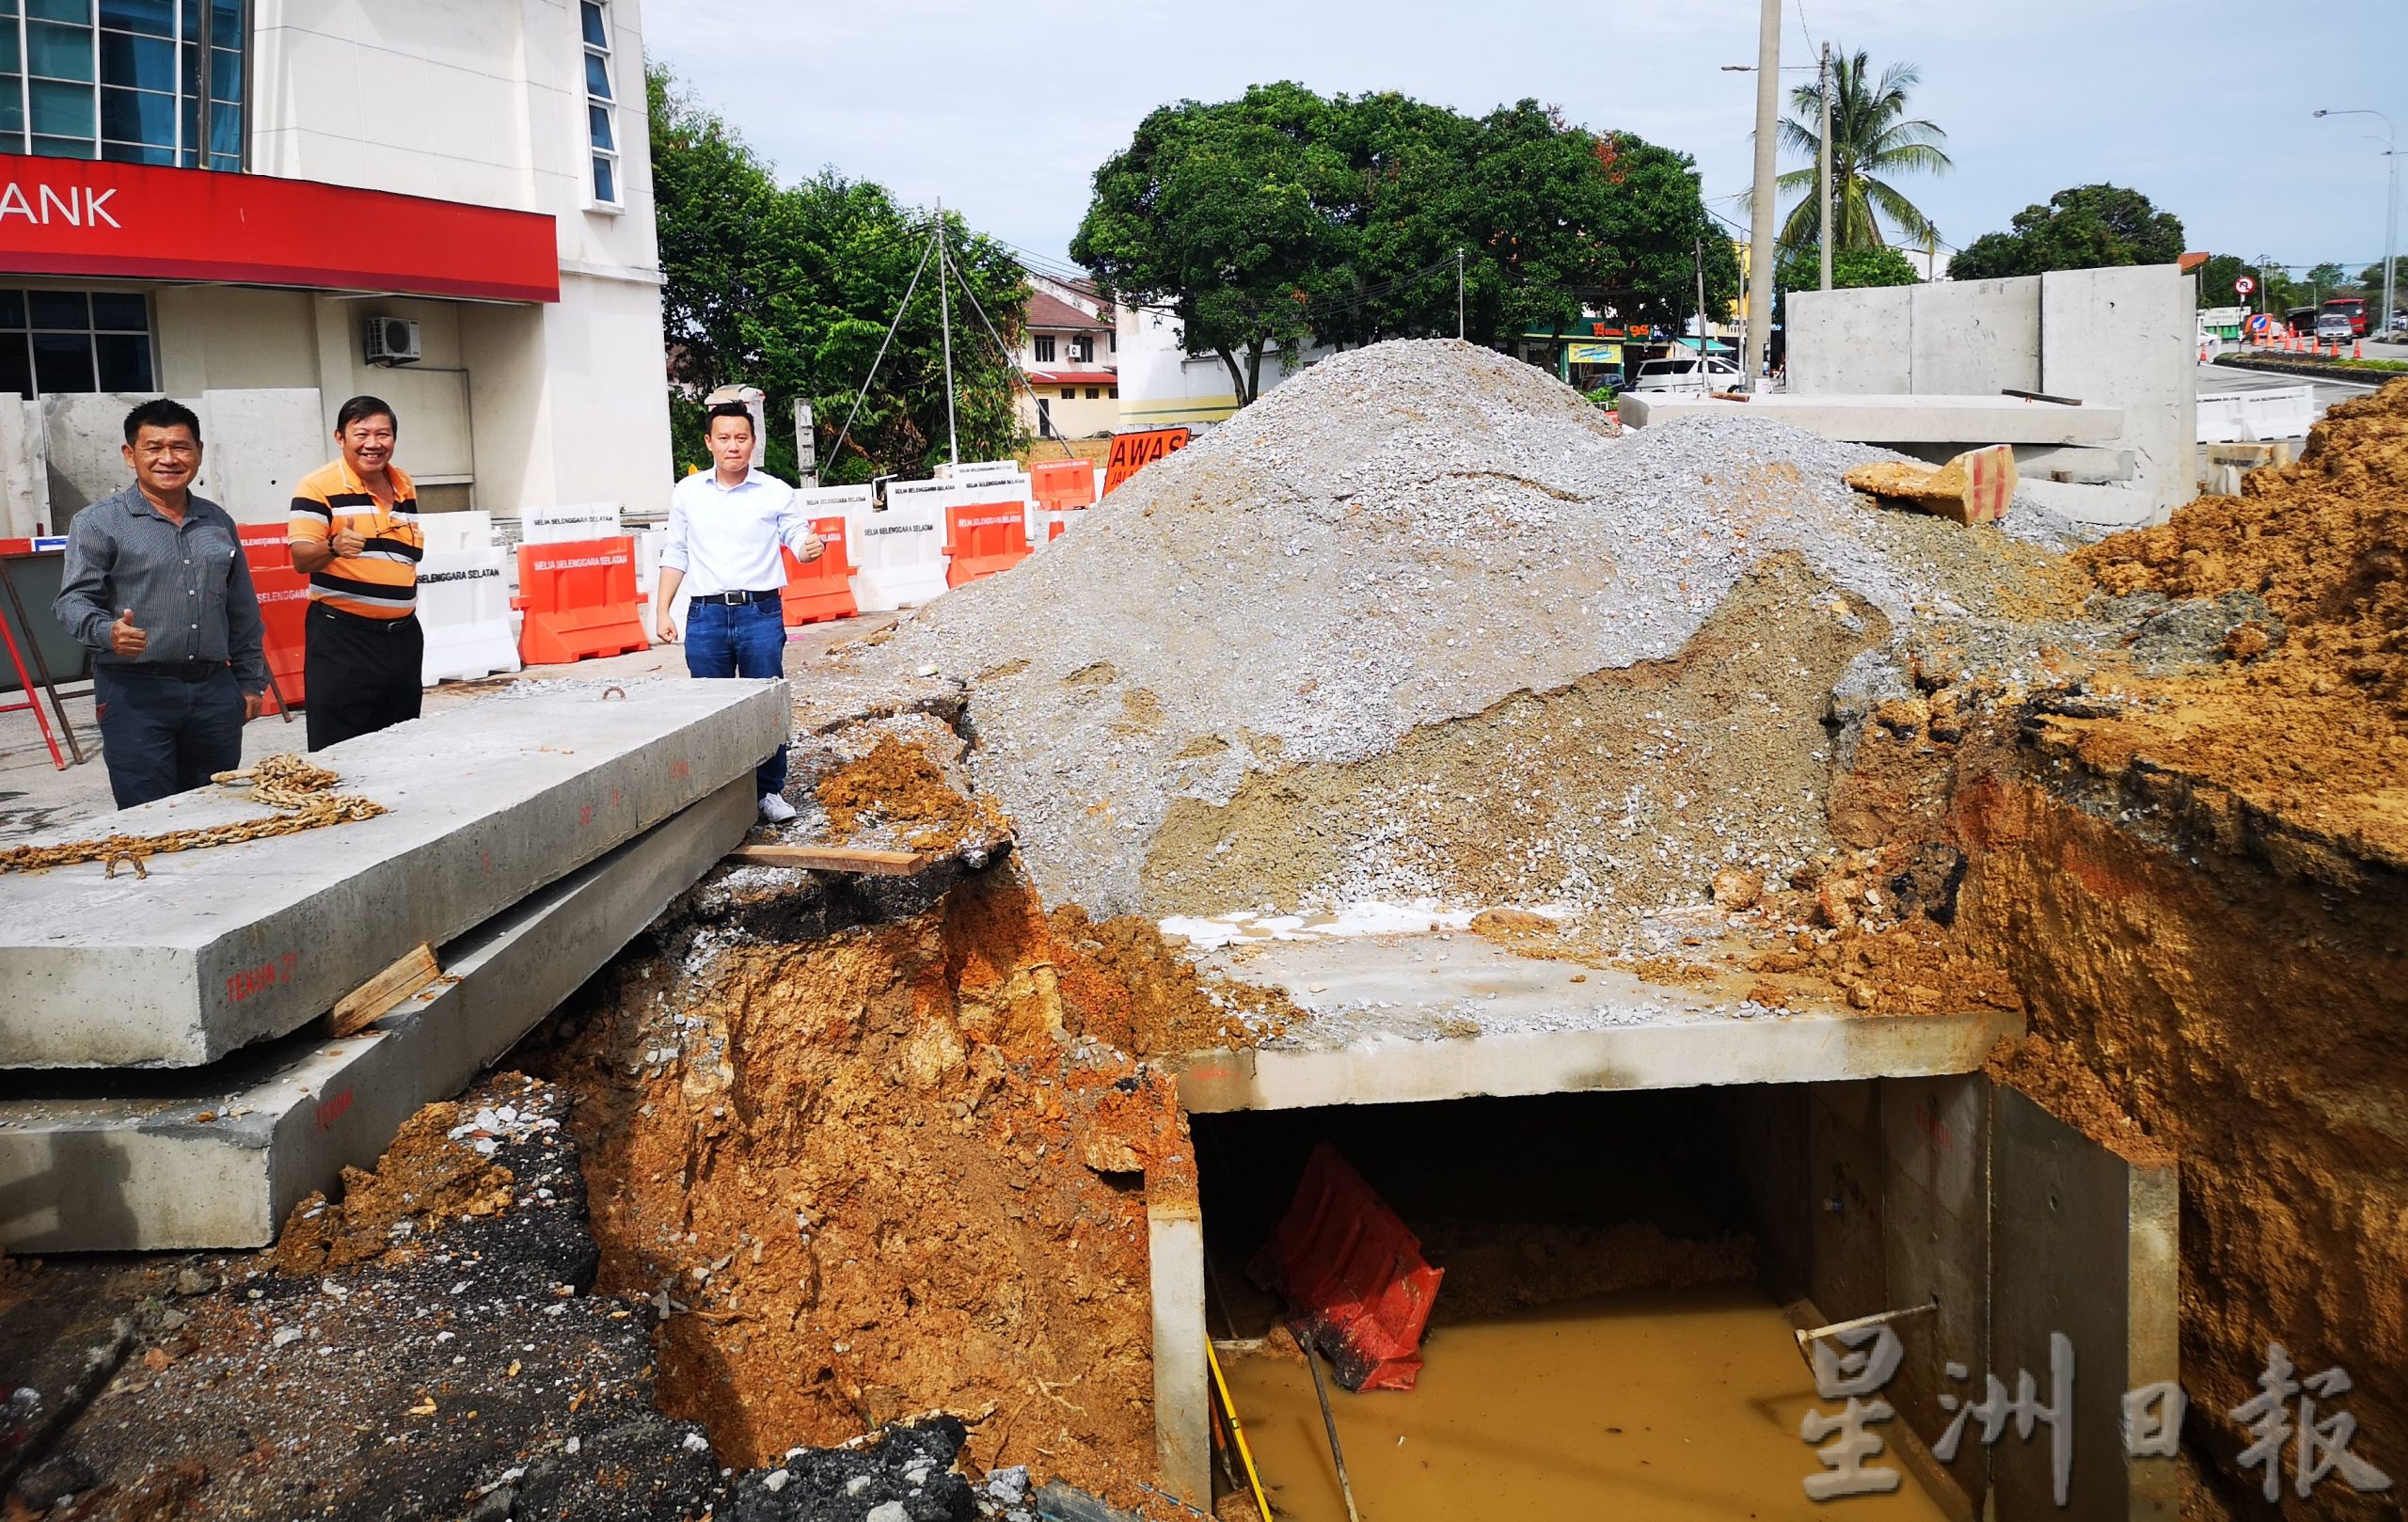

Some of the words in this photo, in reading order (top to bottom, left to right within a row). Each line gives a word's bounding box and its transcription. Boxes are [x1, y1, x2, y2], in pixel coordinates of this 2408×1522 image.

[0, 182, 121, 228] ANK
[1111, 435, 1183, 468] AWAS
[551, 516, 588, 525] SELENGGARA
[879, 526, 912, 535] SELENGGARA
[913, 524, 934, 532] SELATAN
[534, 560, 556, 571] SELIA
[556, 557, 600, 569] SELENGGARA
[600, 555, 627, 565] SELATAN
[417, 570, 467, 583] SELENGGARA
[467, 569, 499, 579] SELATAN
